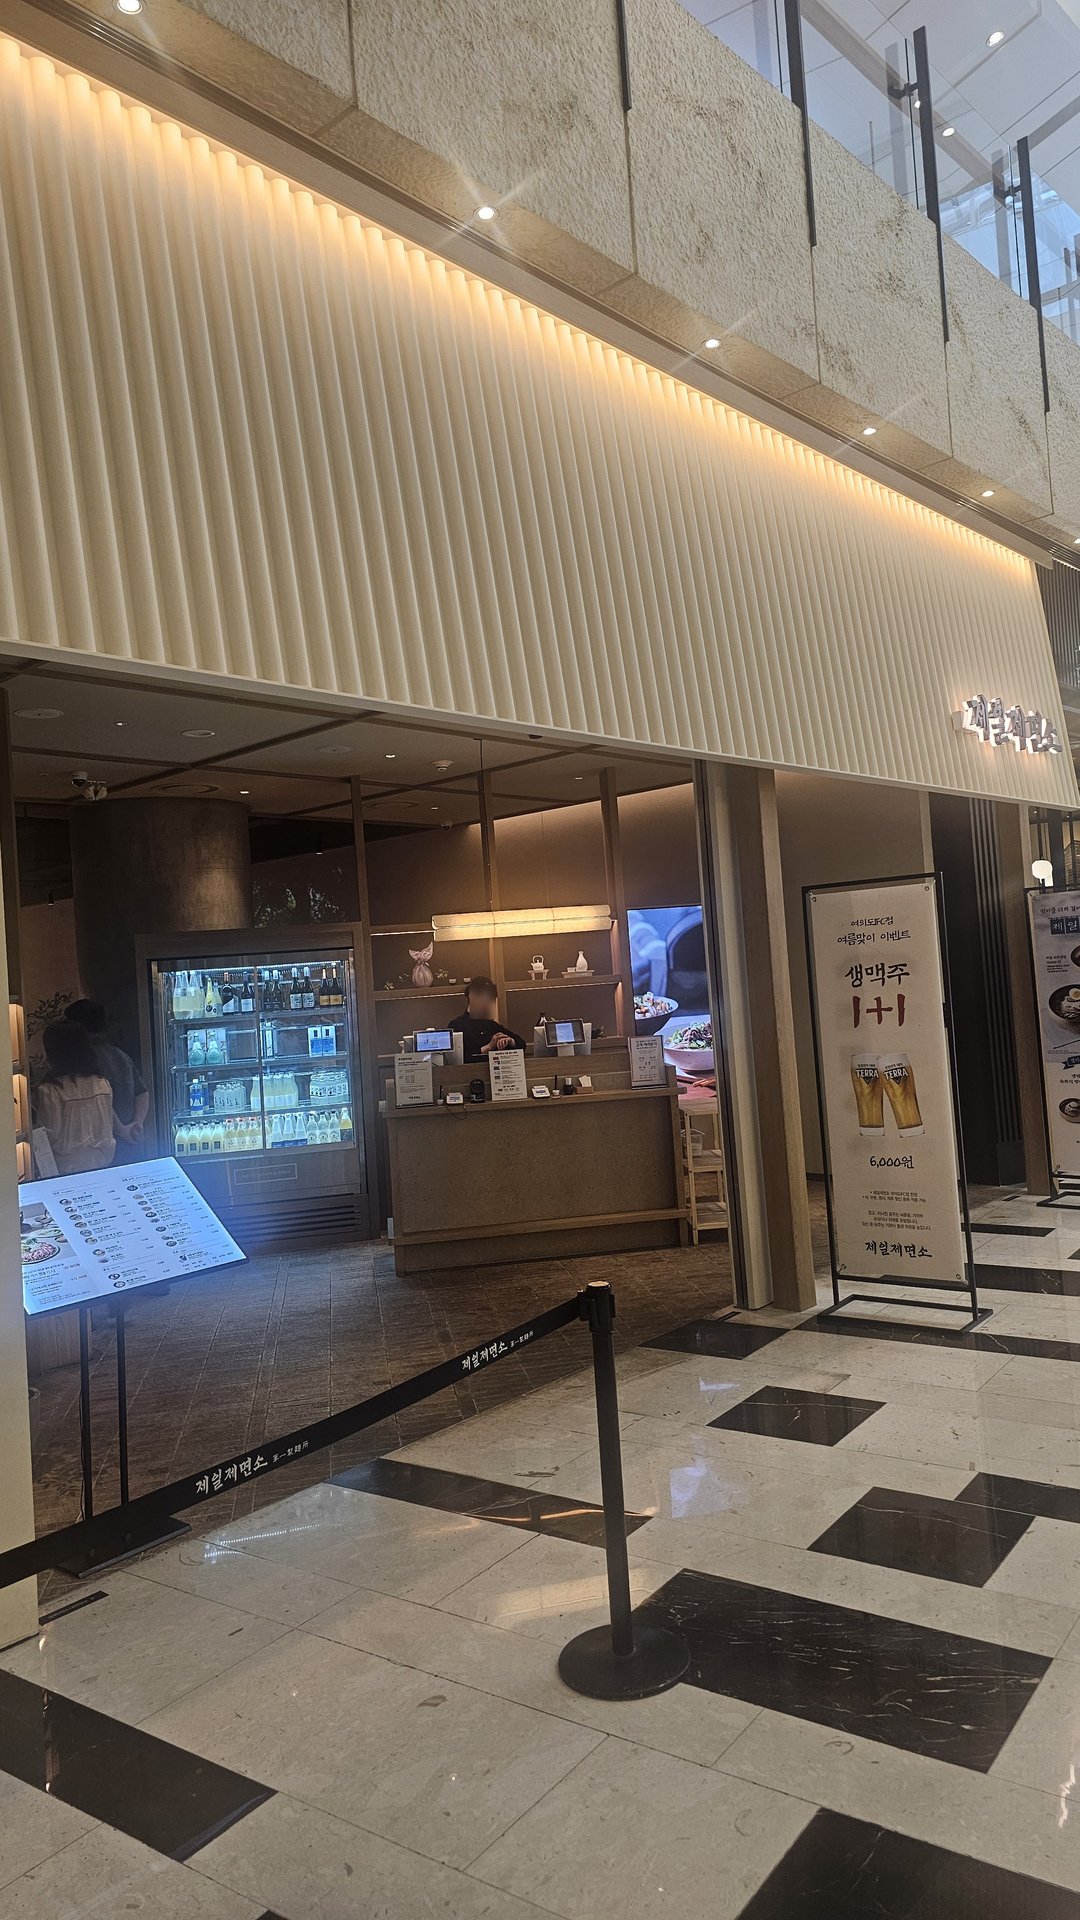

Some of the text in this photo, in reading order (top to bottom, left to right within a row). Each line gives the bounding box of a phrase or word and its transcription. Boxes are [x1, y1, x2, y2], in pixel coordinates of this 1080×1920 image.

[837, 930, 911, 946] 여름맞이 이벤트
[844, 962, 910, 988] 생맥주
[852, 993, 906, 1028] 1+1
[855, 1068, 880, 1079] TERRA
[883, 1068, 909, 1080] TERRA
[869, 1155, 915, 1169] 6,000원
[865, 1240, 933, 1258] 제일제면소
[461, 1340, 508, 1371] 제일제면소
[195, 1454, 269, 1495] 제일제면소
